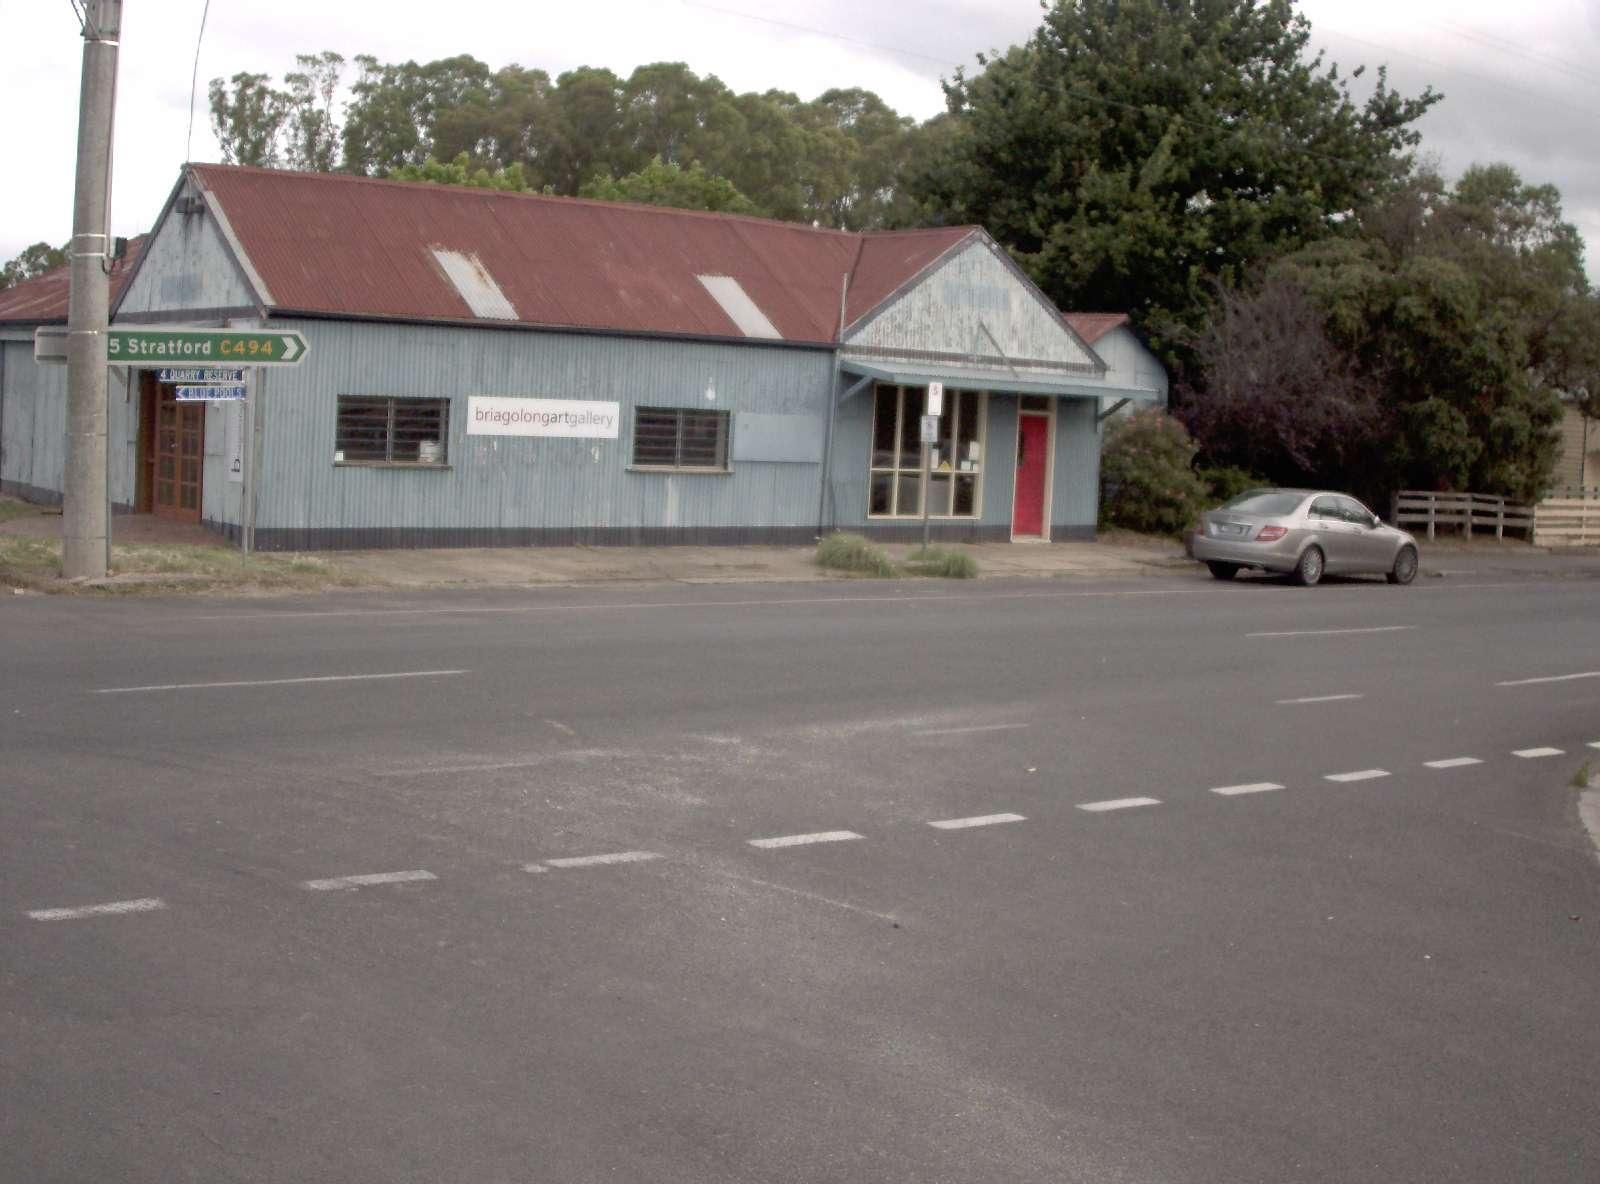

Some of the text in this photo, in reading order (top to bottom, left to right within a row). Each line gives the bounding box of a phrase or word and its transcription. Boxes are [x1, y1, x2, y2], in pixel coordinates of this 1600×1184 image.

[128, 338, 212, 354] Stratford
[219, 339, 273, 355] C494
[475, 406, 615, 428] briagolongartgallery
